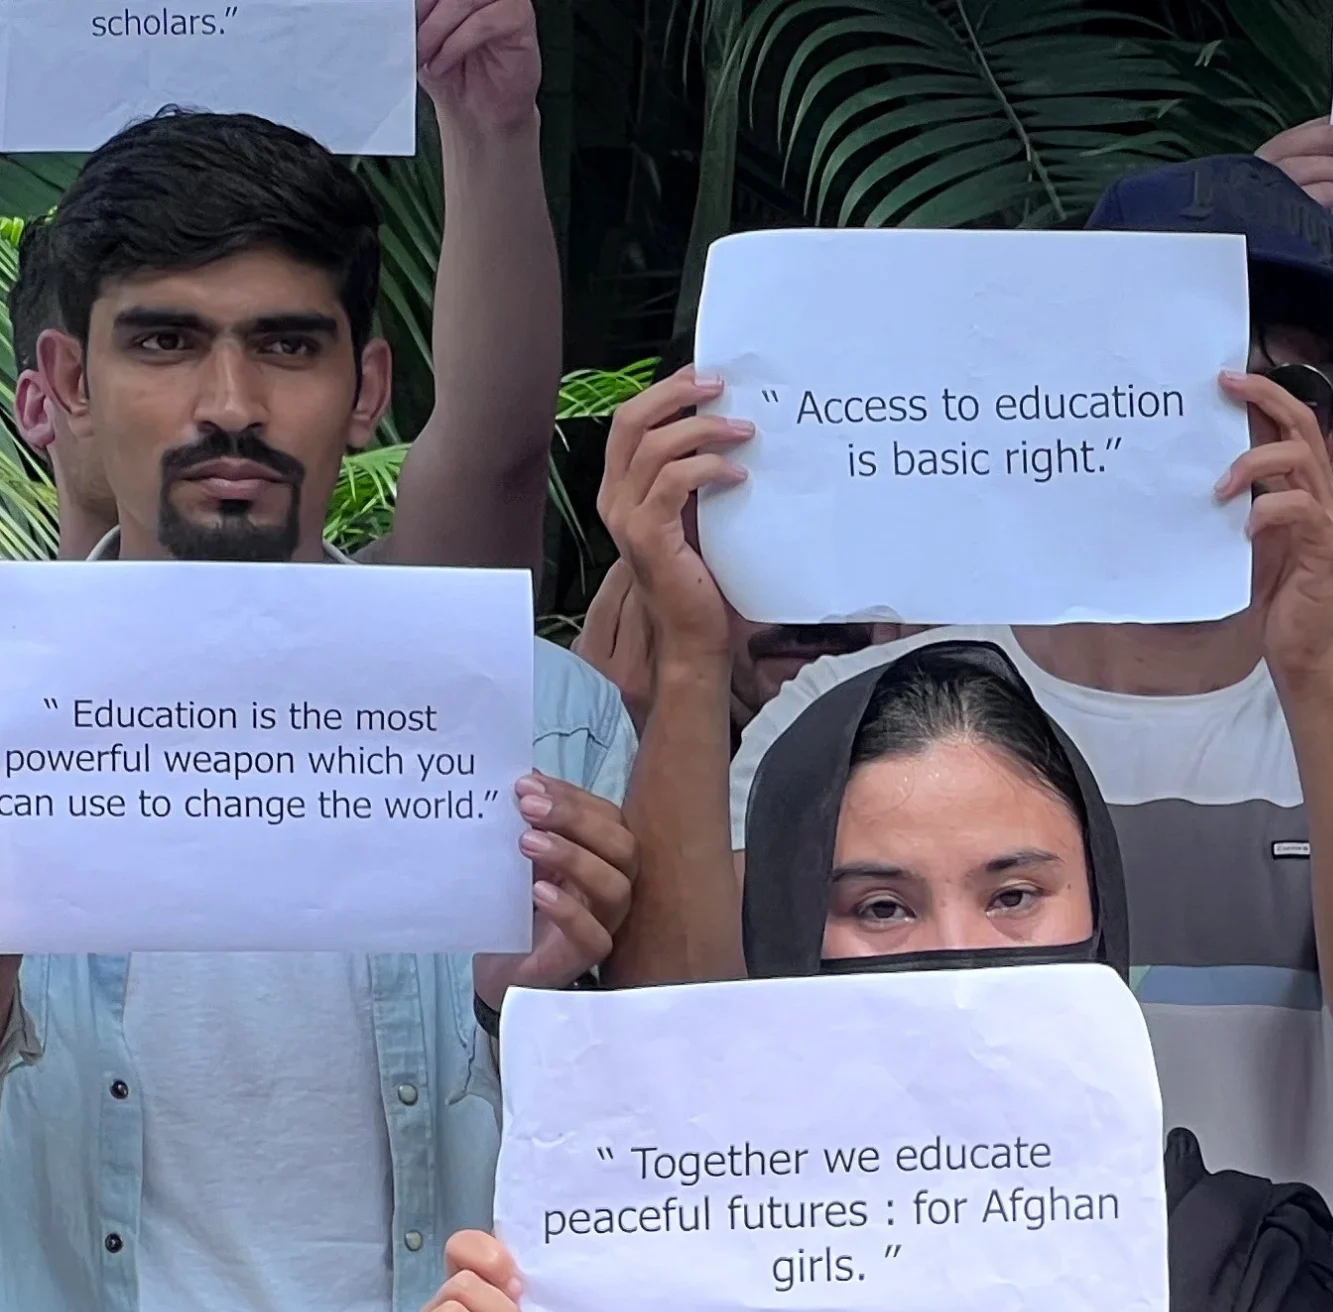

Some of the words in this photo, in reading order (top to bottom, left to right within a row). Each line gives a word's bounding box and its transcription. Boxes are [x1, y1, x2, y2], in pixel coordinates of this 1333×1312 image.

[91, 5, 238, 37] scholars.”
[796, 390, 928, 425] Access
[941, 387, 980, 422] to
[995, 383, 1184, 421] education
[847, 442, 877, 478] is
[893, 440, 991, 477] basic
[1005, 436, 1123, 484] right.”
[73, 697, 237, 730] Education
[252, 700, 277, 730] is
[288, 700, 343, 731] the
[356, 704, 438, 732] most
[5, 742, 150, 779] powerful
[163, 750, 295, 781] weapon
[307, 744, 404, 775] which
[416, 753, 475, 783] you
[0, 793, 54, 817] can
[68, 794, 126, 818] use
[138, 789, 172, 818] to
[184, 787, 306, 826] change
[317, 789, 372, 820] the
[384, 789, 499, 820] world.”
[630, 1140, 809, 1187] Together
[823, 1146, 880, 1174] we
[895, 1134, 1052, 1172] educate
[544, 1194, 711, 1245] peaceful
[727, 1193, 869, 1230] futures
[886, 1199, 895, 1226] :
[912, 1188, 969, 1225] for
[981, 1185, 1119, 1231] Afghan
[772, 1245, 866, 1293] girls.
